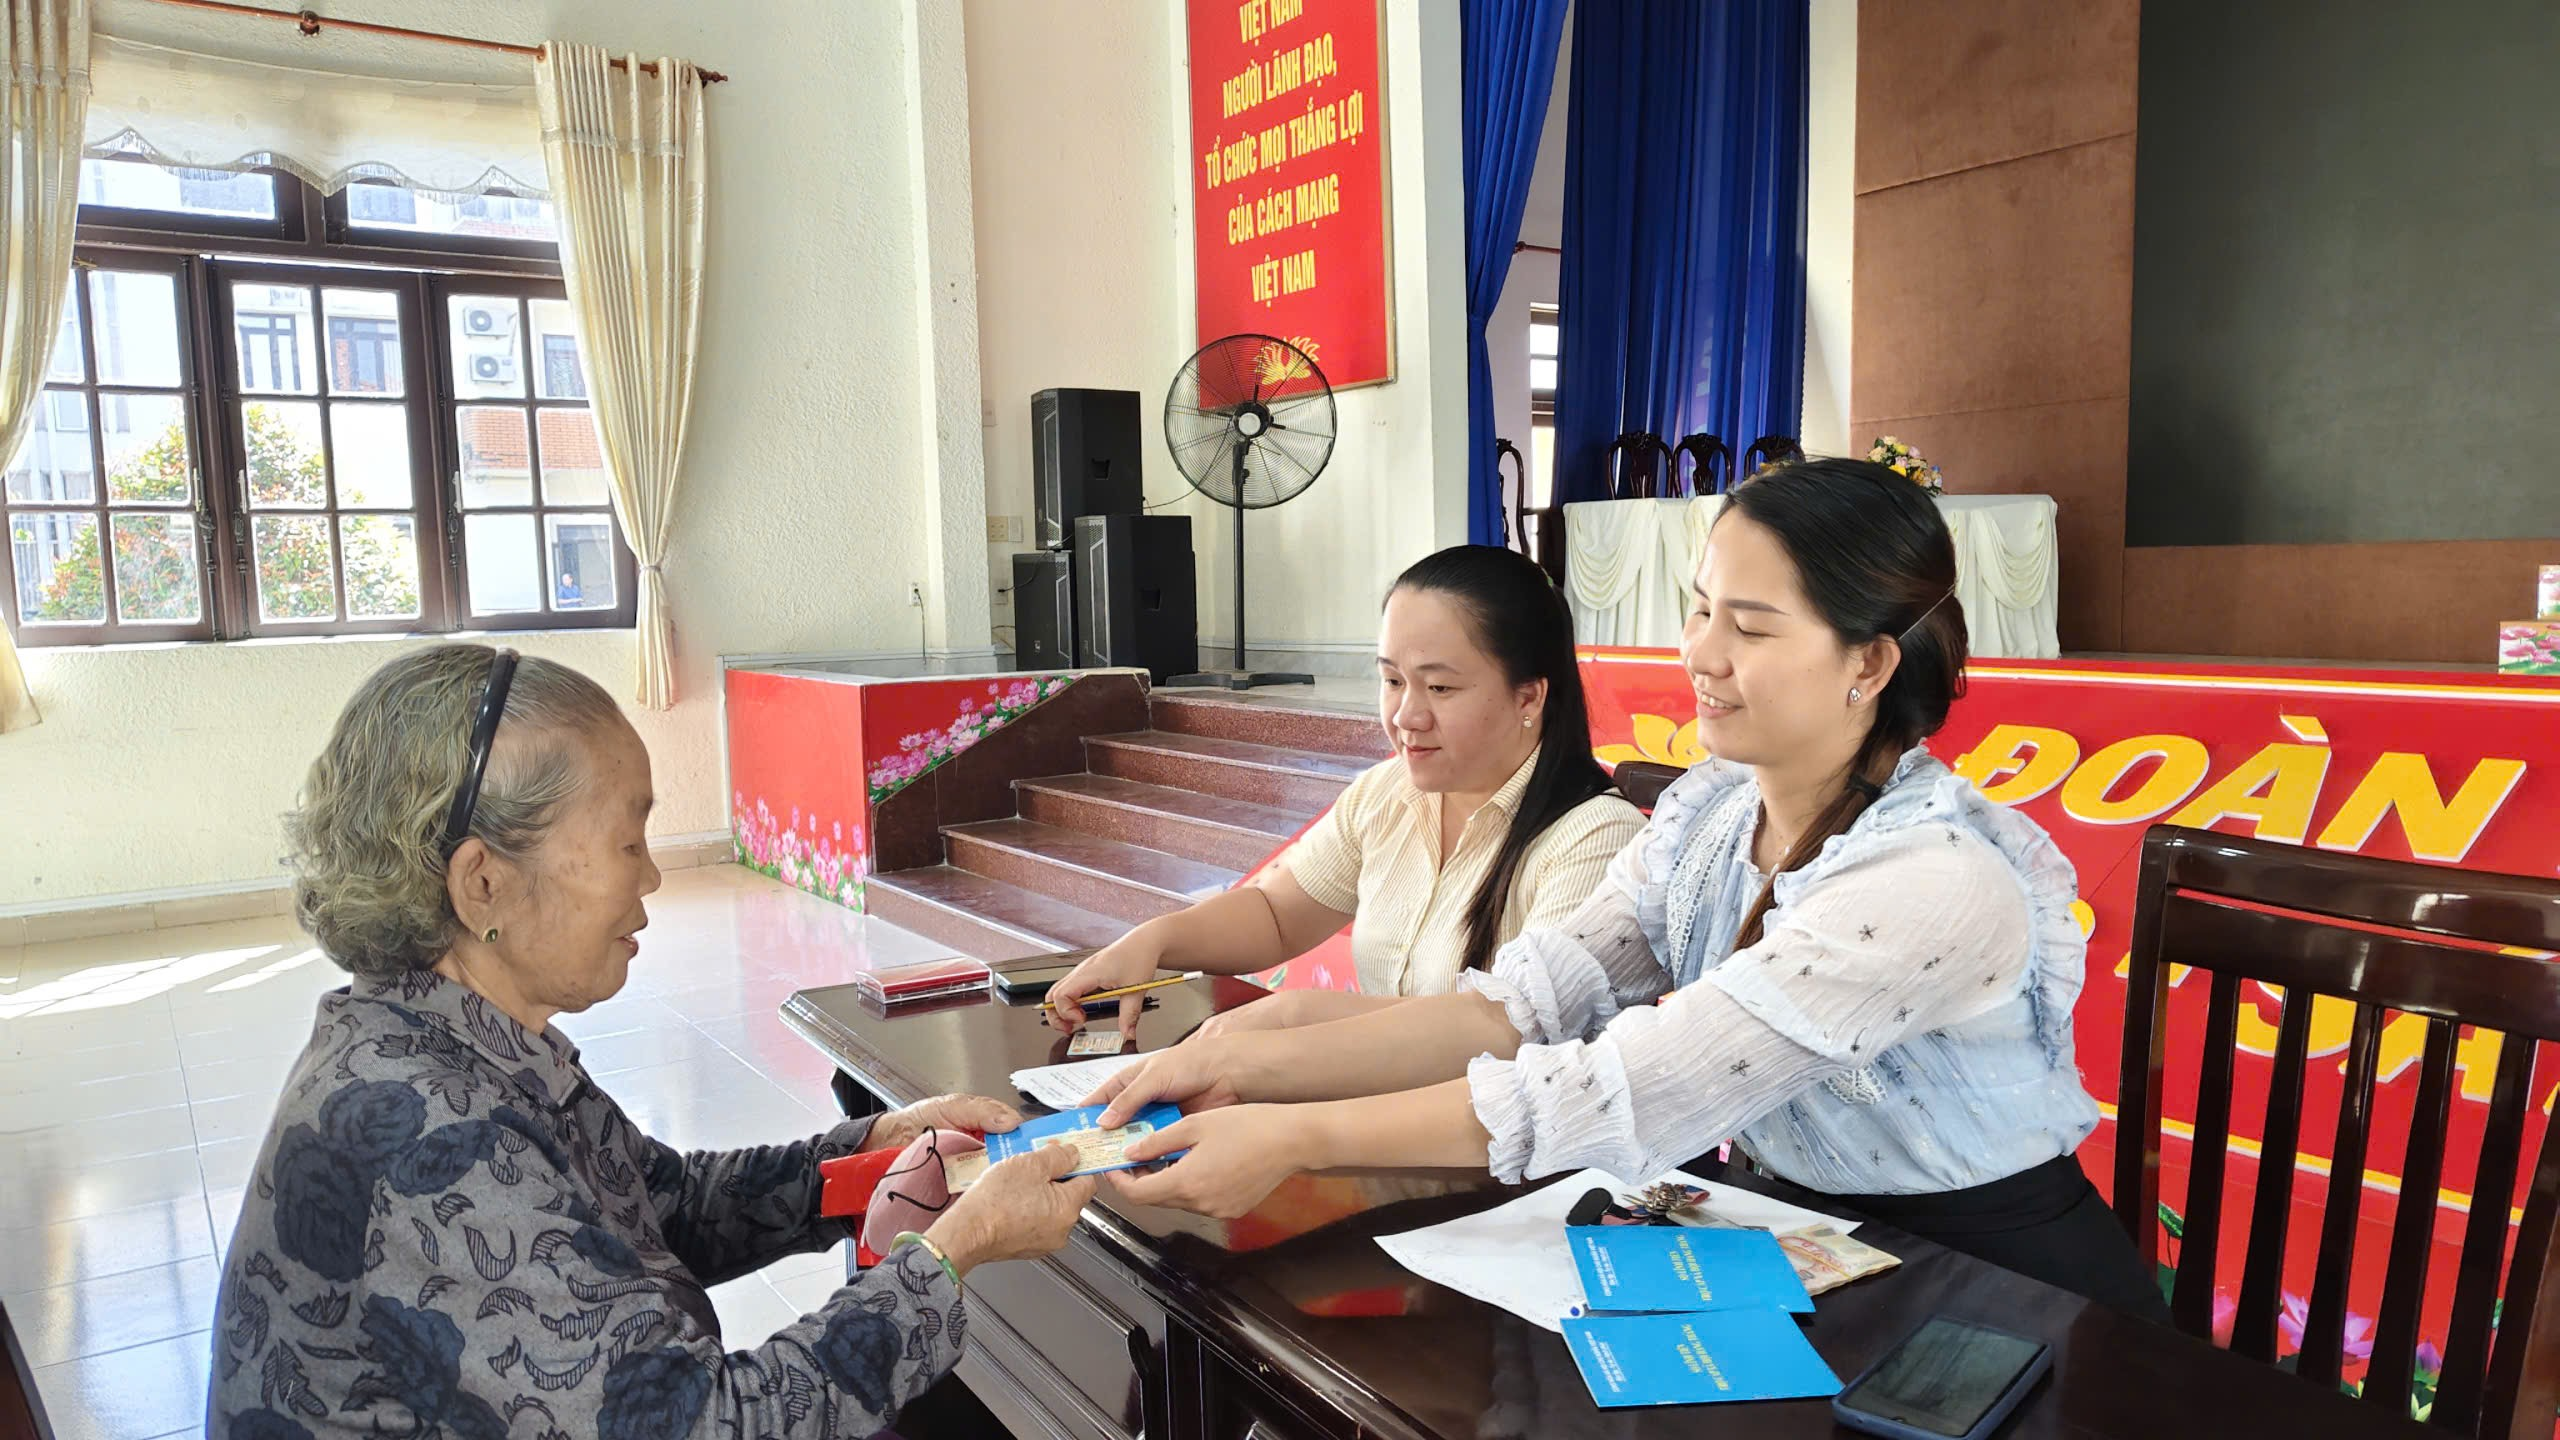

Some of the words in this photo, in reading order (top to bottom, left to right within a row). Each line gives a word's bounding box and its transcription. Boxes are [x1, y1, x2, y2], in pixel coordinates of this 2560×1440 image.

[1223, 59, 1262, 119] NGƯỜI
[1265, 49, 1301, 101] LÃNH
[1304, 32, 1337, 87] ĐẠO,
[1205, 135, 1221, 189] TỔ
[1223, 130, 1257, 184] CHỨC
[1260, 122, 1287, 173] MỌI
[1289, 97, 1336, 158] THẮNG
[1340, 89, 1364, 145] LỢI
[1228, 193, 1254, 245] CỦA
[1257, 187, 1293, 237] CÁCH
[1296, 173, 1340, 229] MẠNG
[1251, 254, 1279, 308] VIỆT
[1282, 249, 1316, 295] NAM
[1954, 714, 2527, 863] ĐOÀN
